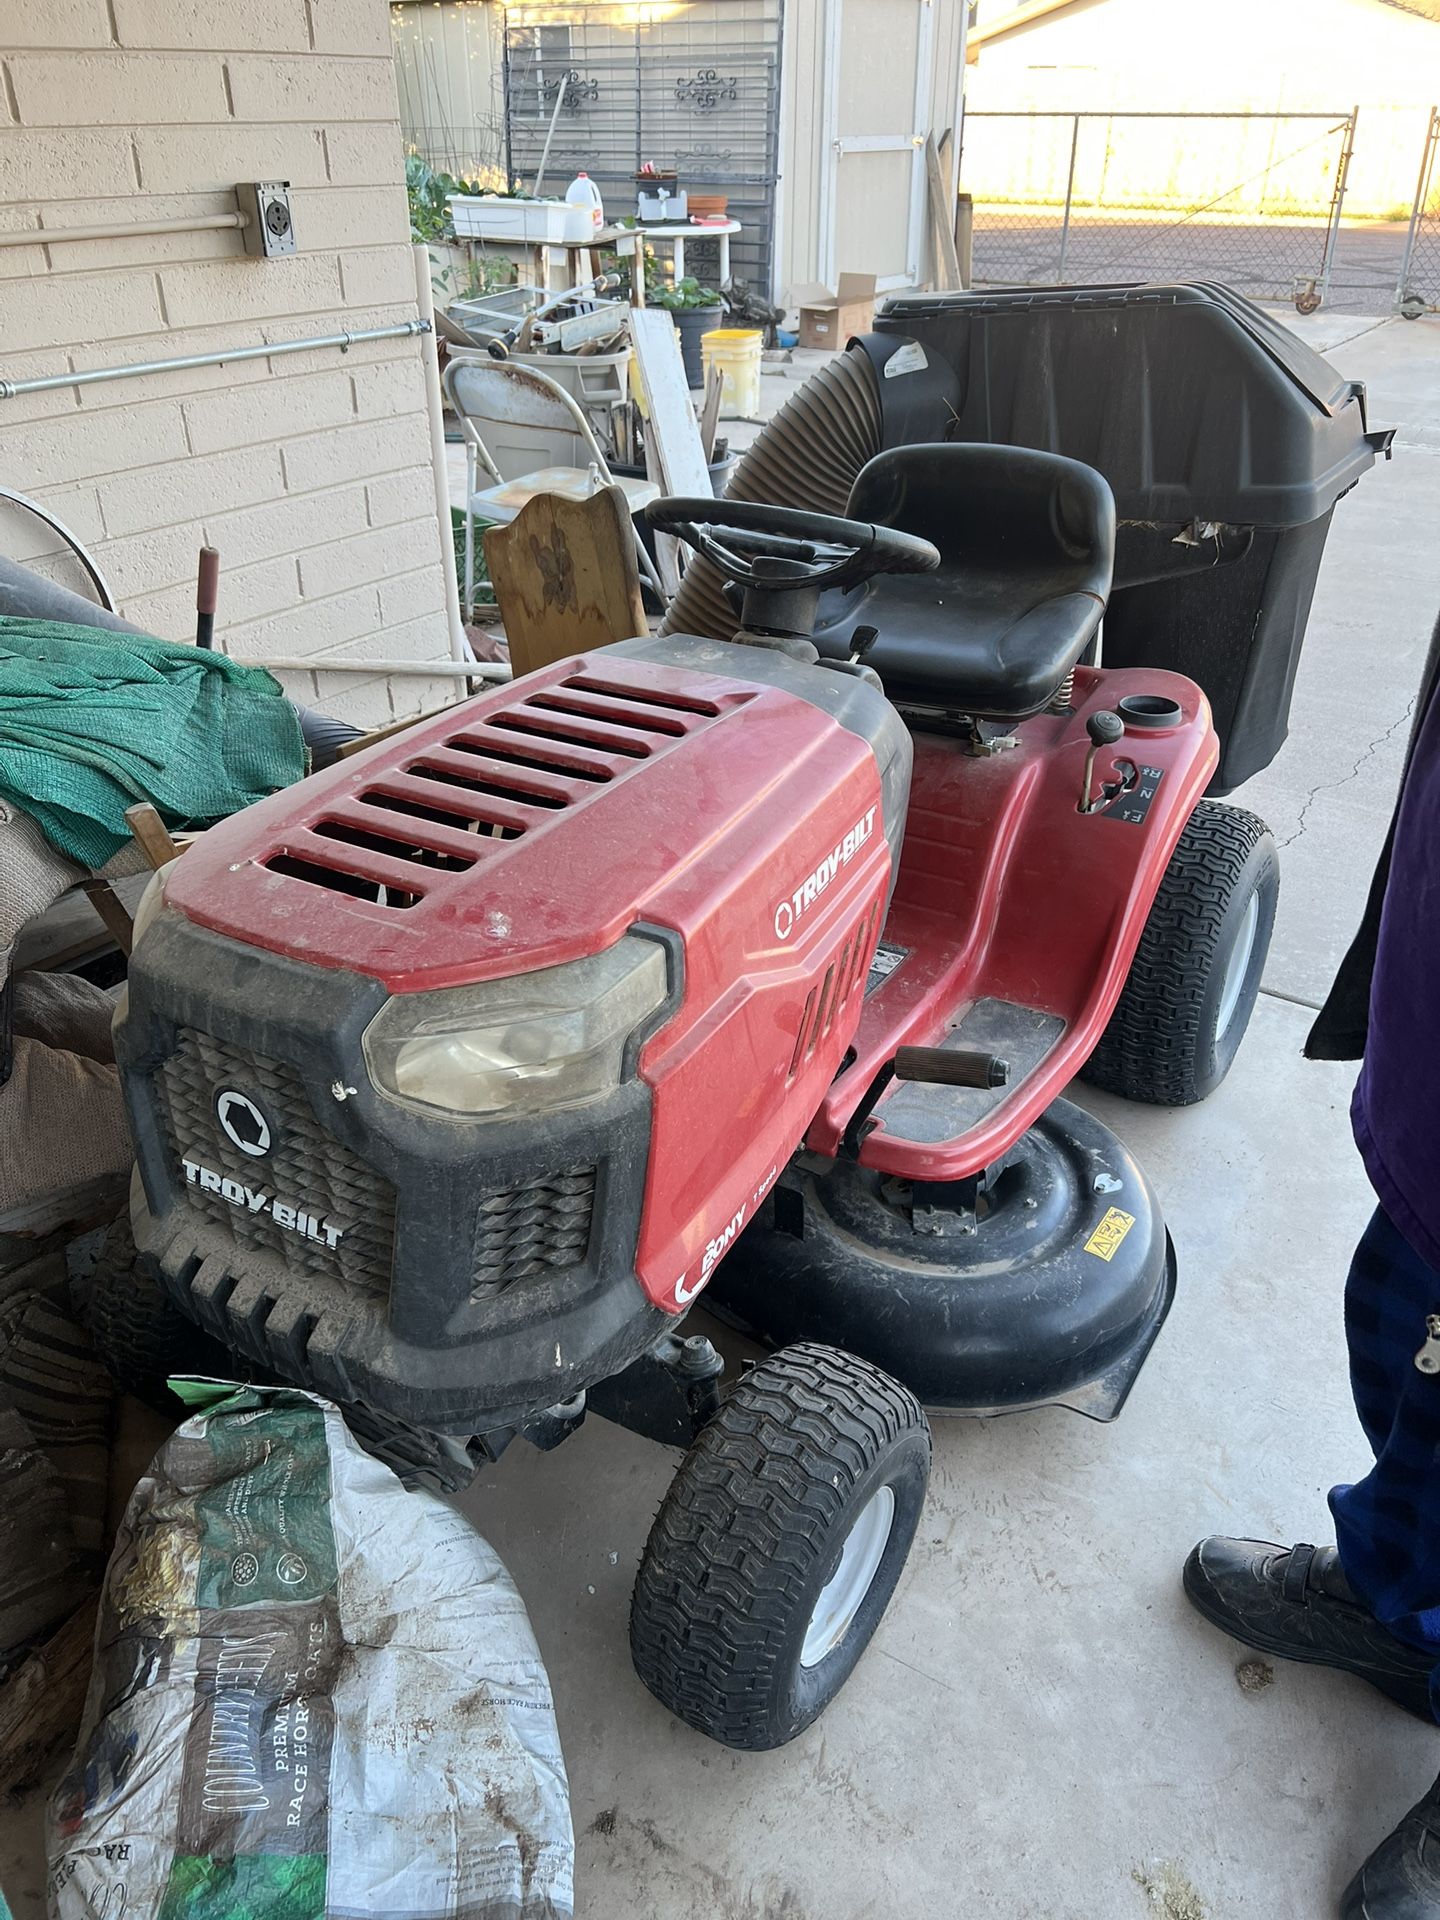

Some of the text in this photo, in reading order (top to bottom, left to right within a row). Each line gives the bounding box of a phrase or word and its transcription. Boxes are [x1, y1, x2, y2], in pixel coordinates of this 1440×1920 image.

[1140, 790, 1151, 798] N
[1150, 769, 1161, 778] R
[1131, 814, 1142, 822] F
[792, 806, 876, 920] TROY-BILT
[181, 1159, 343, 1250] TROY-BILT
[278, 1498, 286, 1534] QUALITY
[202, 1631, 288, 1812] COUNTRY FEEDS
[273, 1672, 299, 1772] PREMIUM
[287, 1764, 308, 1827] RACE
